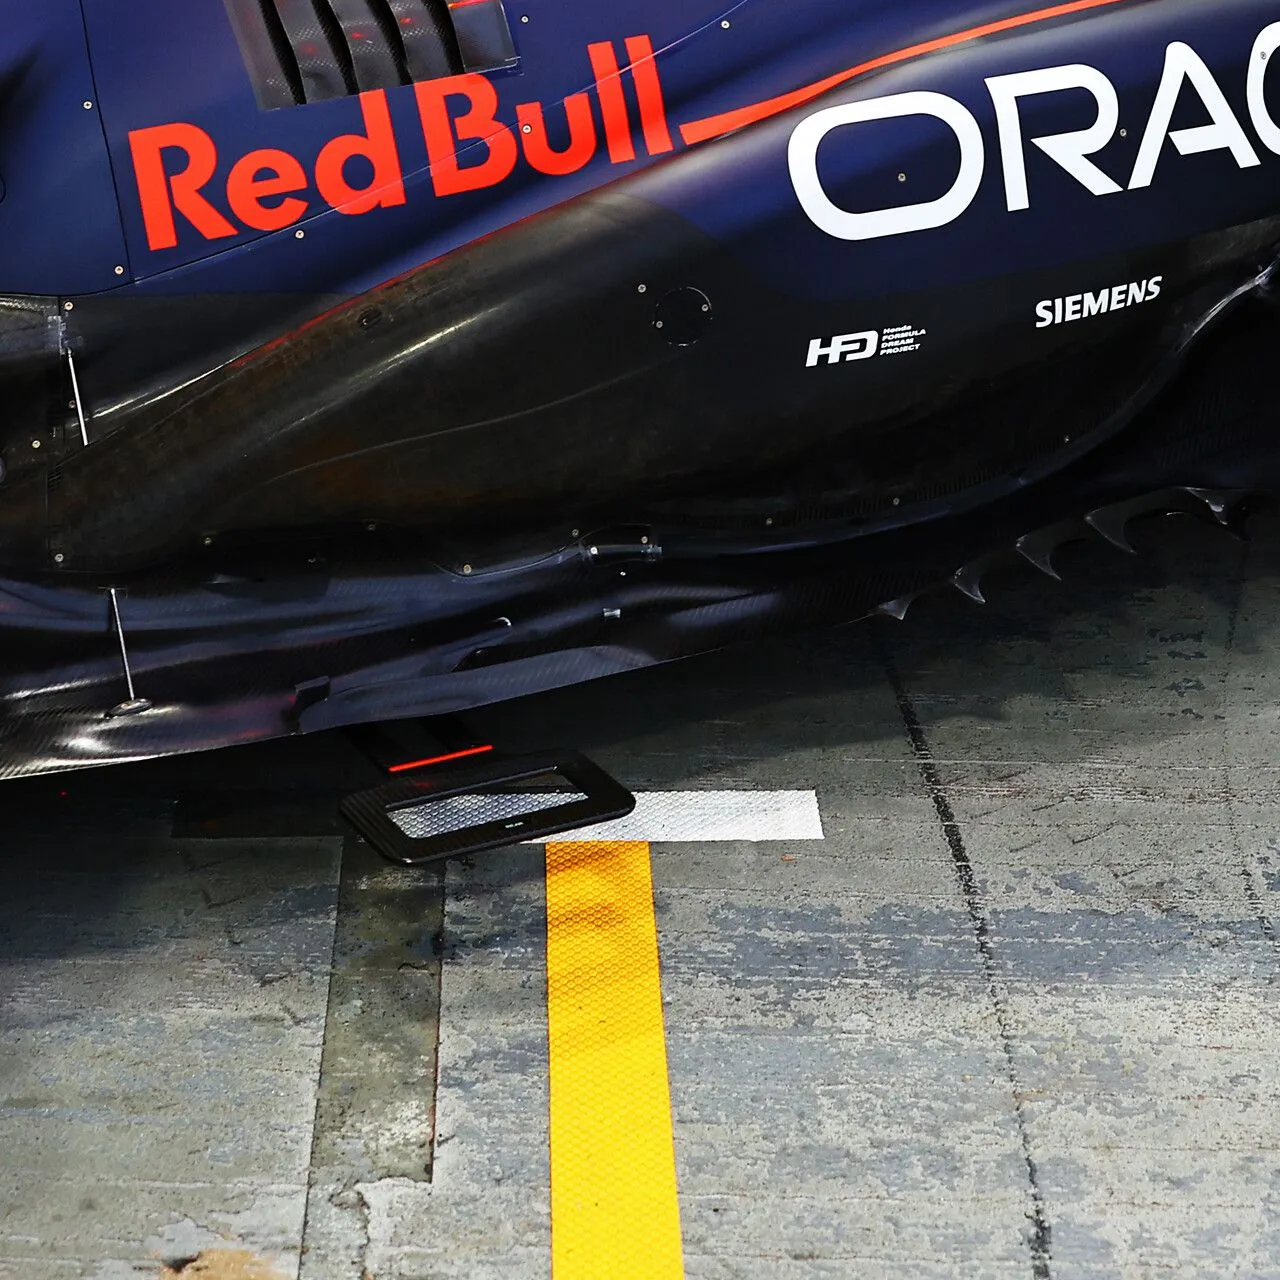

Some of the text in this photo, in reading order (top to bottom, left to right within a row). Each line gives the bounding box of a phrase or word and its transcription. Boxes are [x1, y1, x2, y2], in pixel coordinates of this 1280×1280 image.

[128, 34, 675, 252] Red Bull
[1035, 275, 1163, 329] SIEMENS
[881, 327, 928, 342] FORMULA
[883, 324, 913, 336] Honda
[879, 343, 922, 357] PROJECT
[880, 337, 915, 350] DREAM
